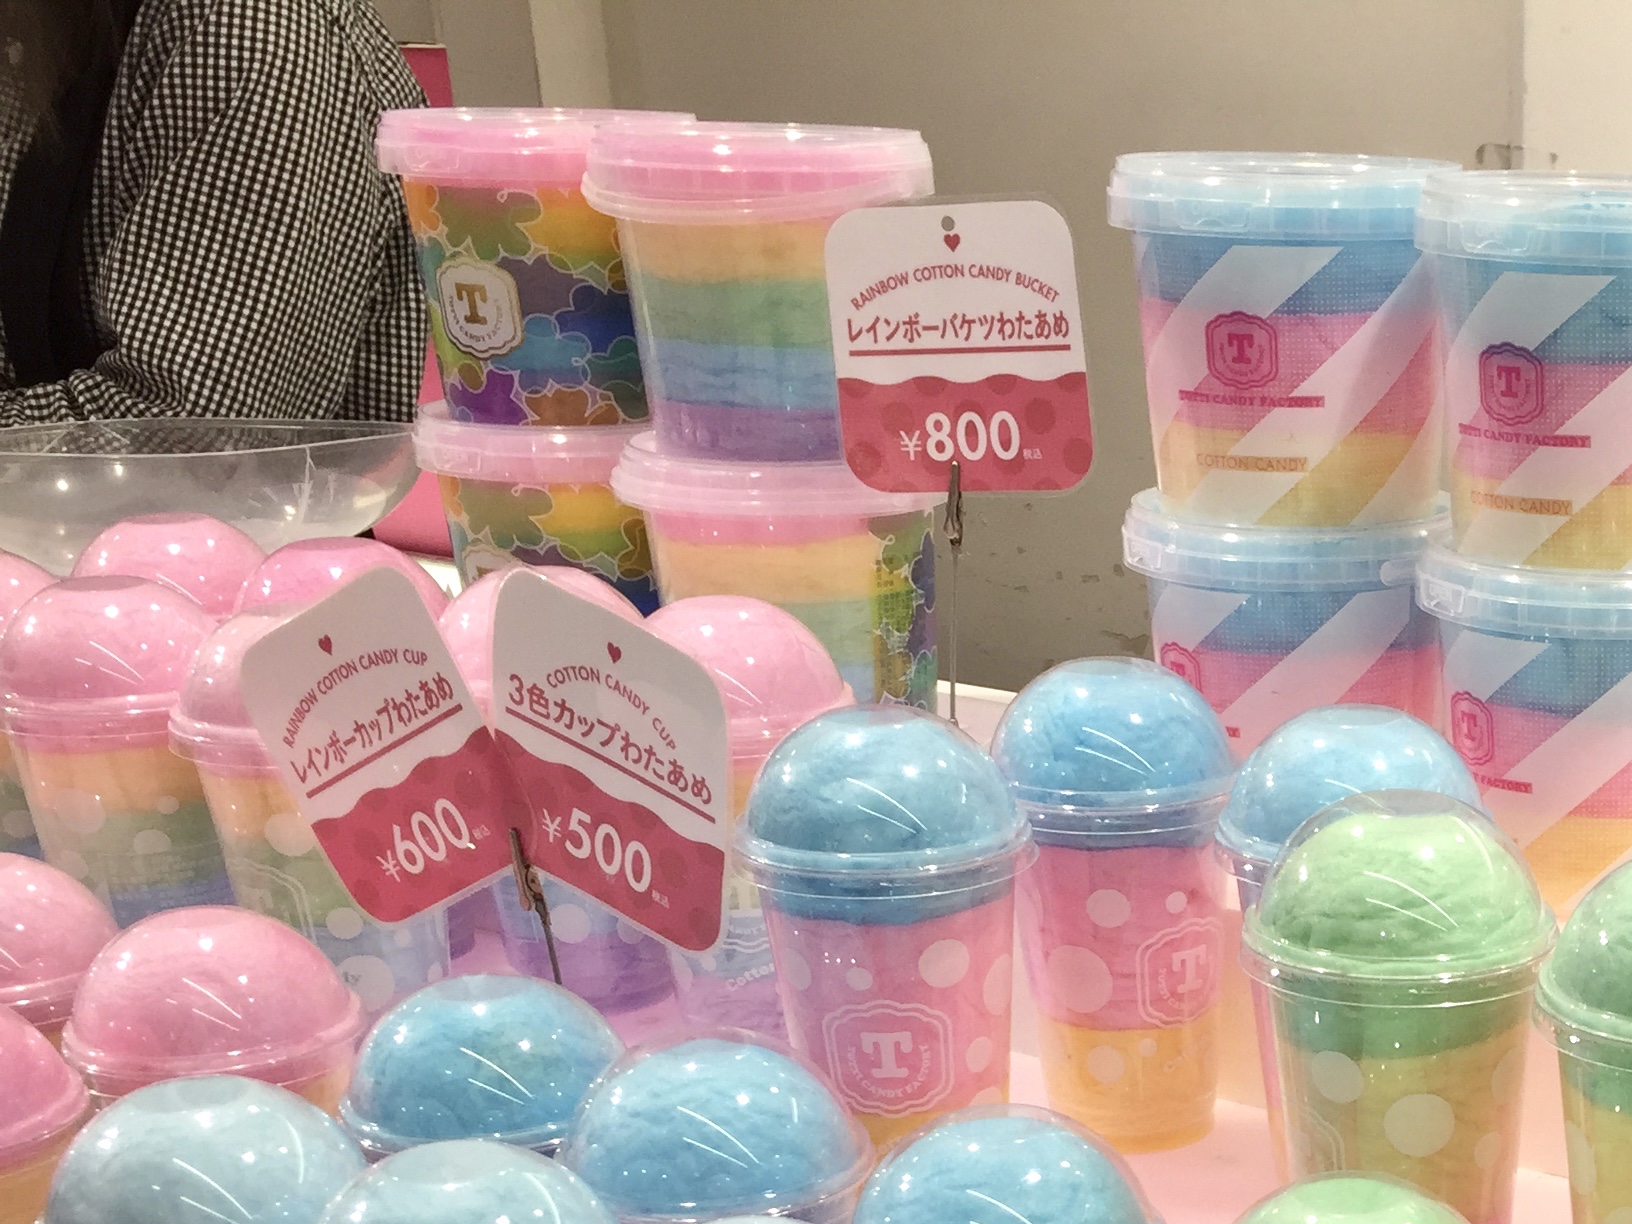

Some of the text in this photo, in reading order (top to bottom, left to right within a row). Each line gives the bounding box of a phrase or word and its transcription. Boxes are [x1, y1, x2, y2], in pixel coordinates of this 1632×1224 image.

[850, 264, 1060, 311] RAINBOW COTTON CANDY BUCKET
[846, 310, 1069, 344] レインボーバケツわたあめ
[1227, 333, 1255, 364] T
[1496, 365, 1521, 398] T
[899, 410, 1021, 462] ¥800
[1196, 453, 1307, 471] COTTON CANDY
[1519, 498, 1571, 515] CANDY
[282, 648, 428, 749] RAINBOW COTTON CANDY CUP
[546, 665, 677, 751] COTTON CANDY CUP
[290, 671, 454, 784] レインボーカップわたあめ
[508, 673, 712, 805] 3色カップわたあめ
[376, 798, 470, 883] ¥600
[542, 806, 652, 893] ¥500
[1172, 944, 1206, 993] T
[860, 1031, 913, 1079] T
